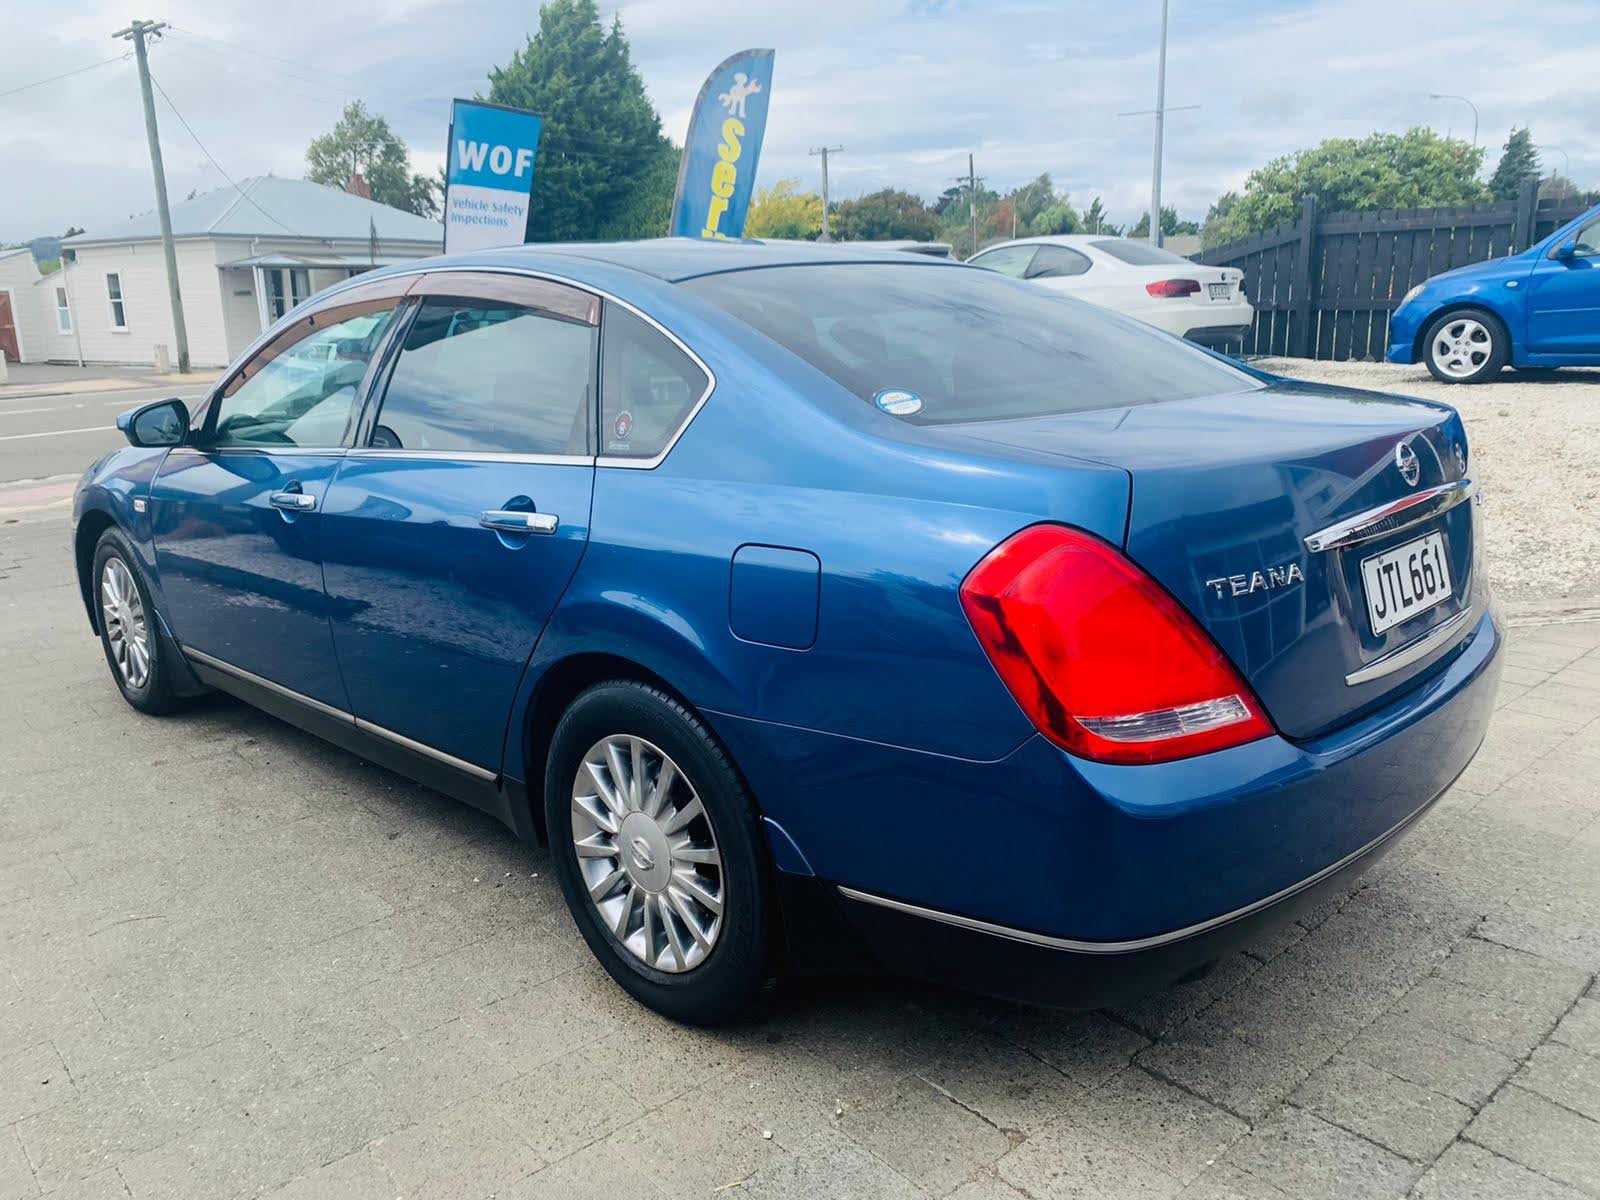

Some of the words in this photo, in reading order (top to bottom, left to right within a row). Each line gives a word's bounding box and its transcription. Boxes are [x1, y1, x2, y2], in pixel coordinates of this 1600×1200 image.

[457, 139, 534, 178] WOF
[702, 117, 746, 239] Ser
[451, 212, 509, 228] Inspections
[452, 197, 489, 212] Vehicle
[492, 202, 525, 217] Safety
[1206, 563, 1305, 600] TEANA
[1374, 544, 1446, 619] JTL661
